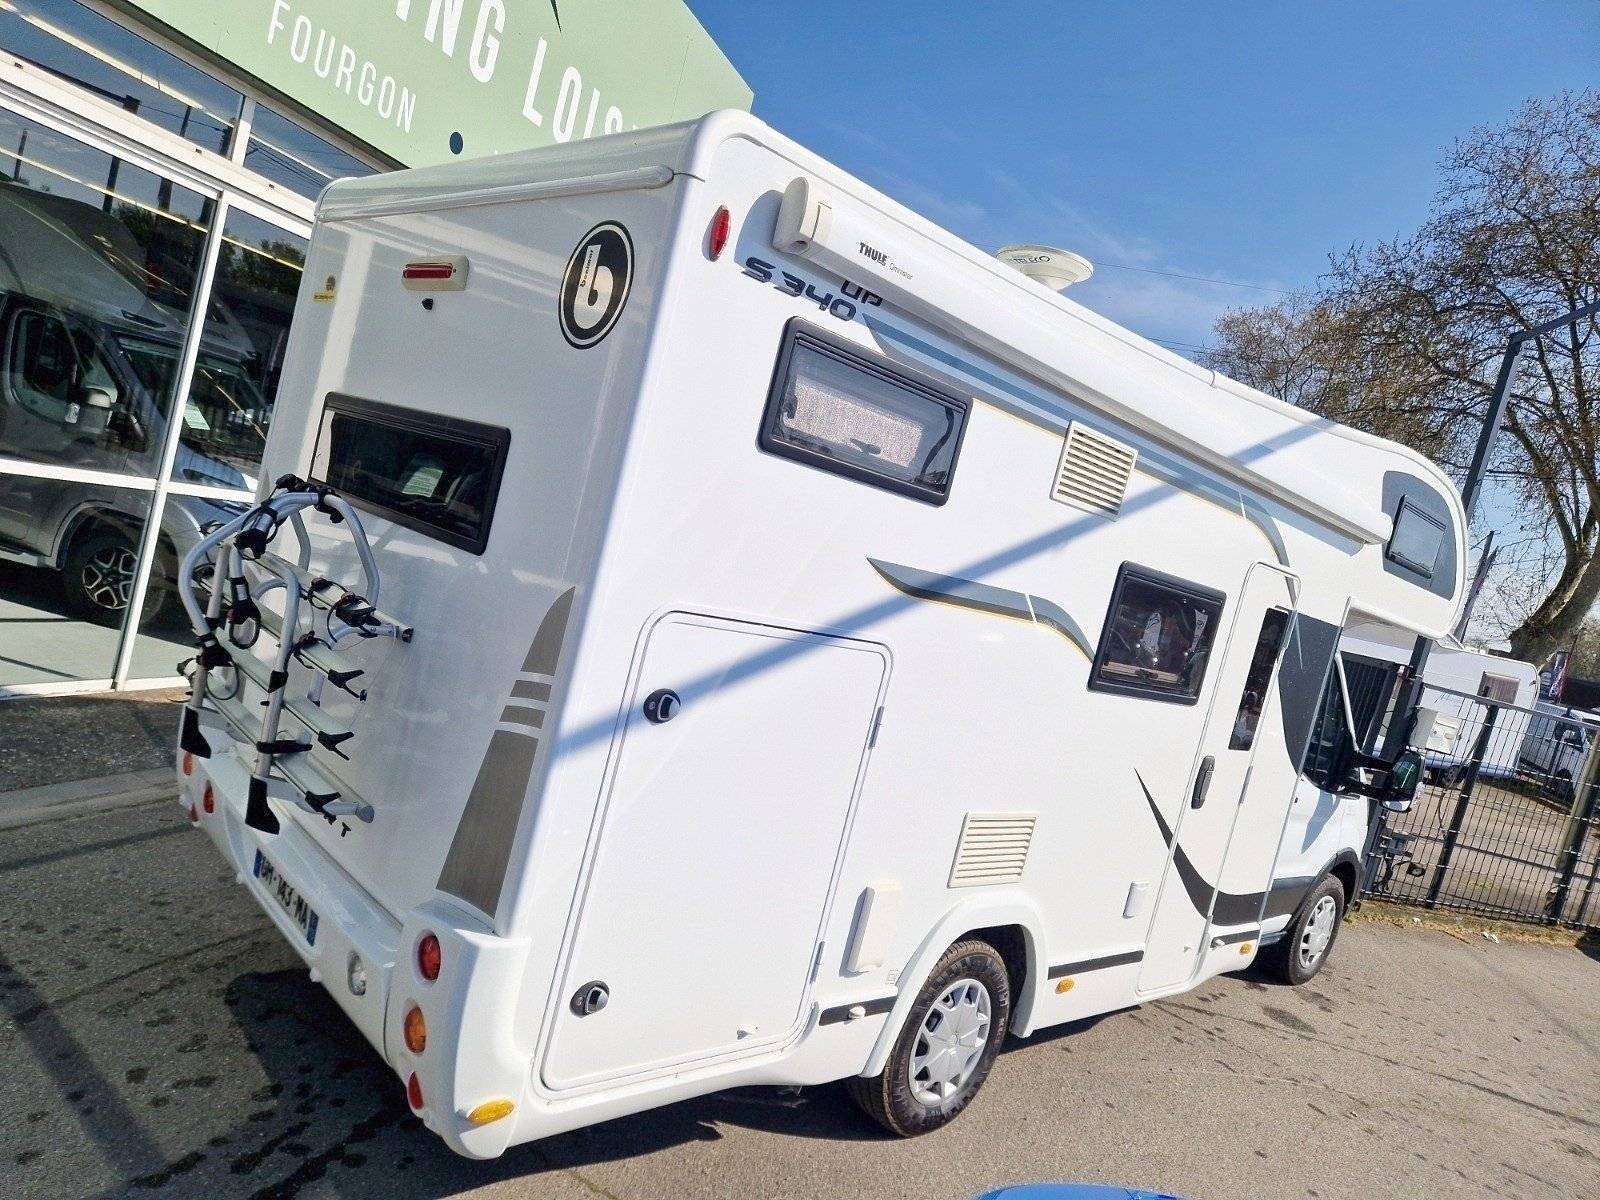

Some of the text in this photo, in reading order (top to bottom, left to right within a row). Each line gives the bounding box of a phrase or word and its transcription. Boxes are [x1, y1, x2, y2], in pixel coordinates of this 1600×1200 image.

[266, 0, 417, 134] FOURGON
[396, 0, 639, 144] NG LOI
[840, 279, 883, 307] UP
[859, 241, 888, 266] THULE
